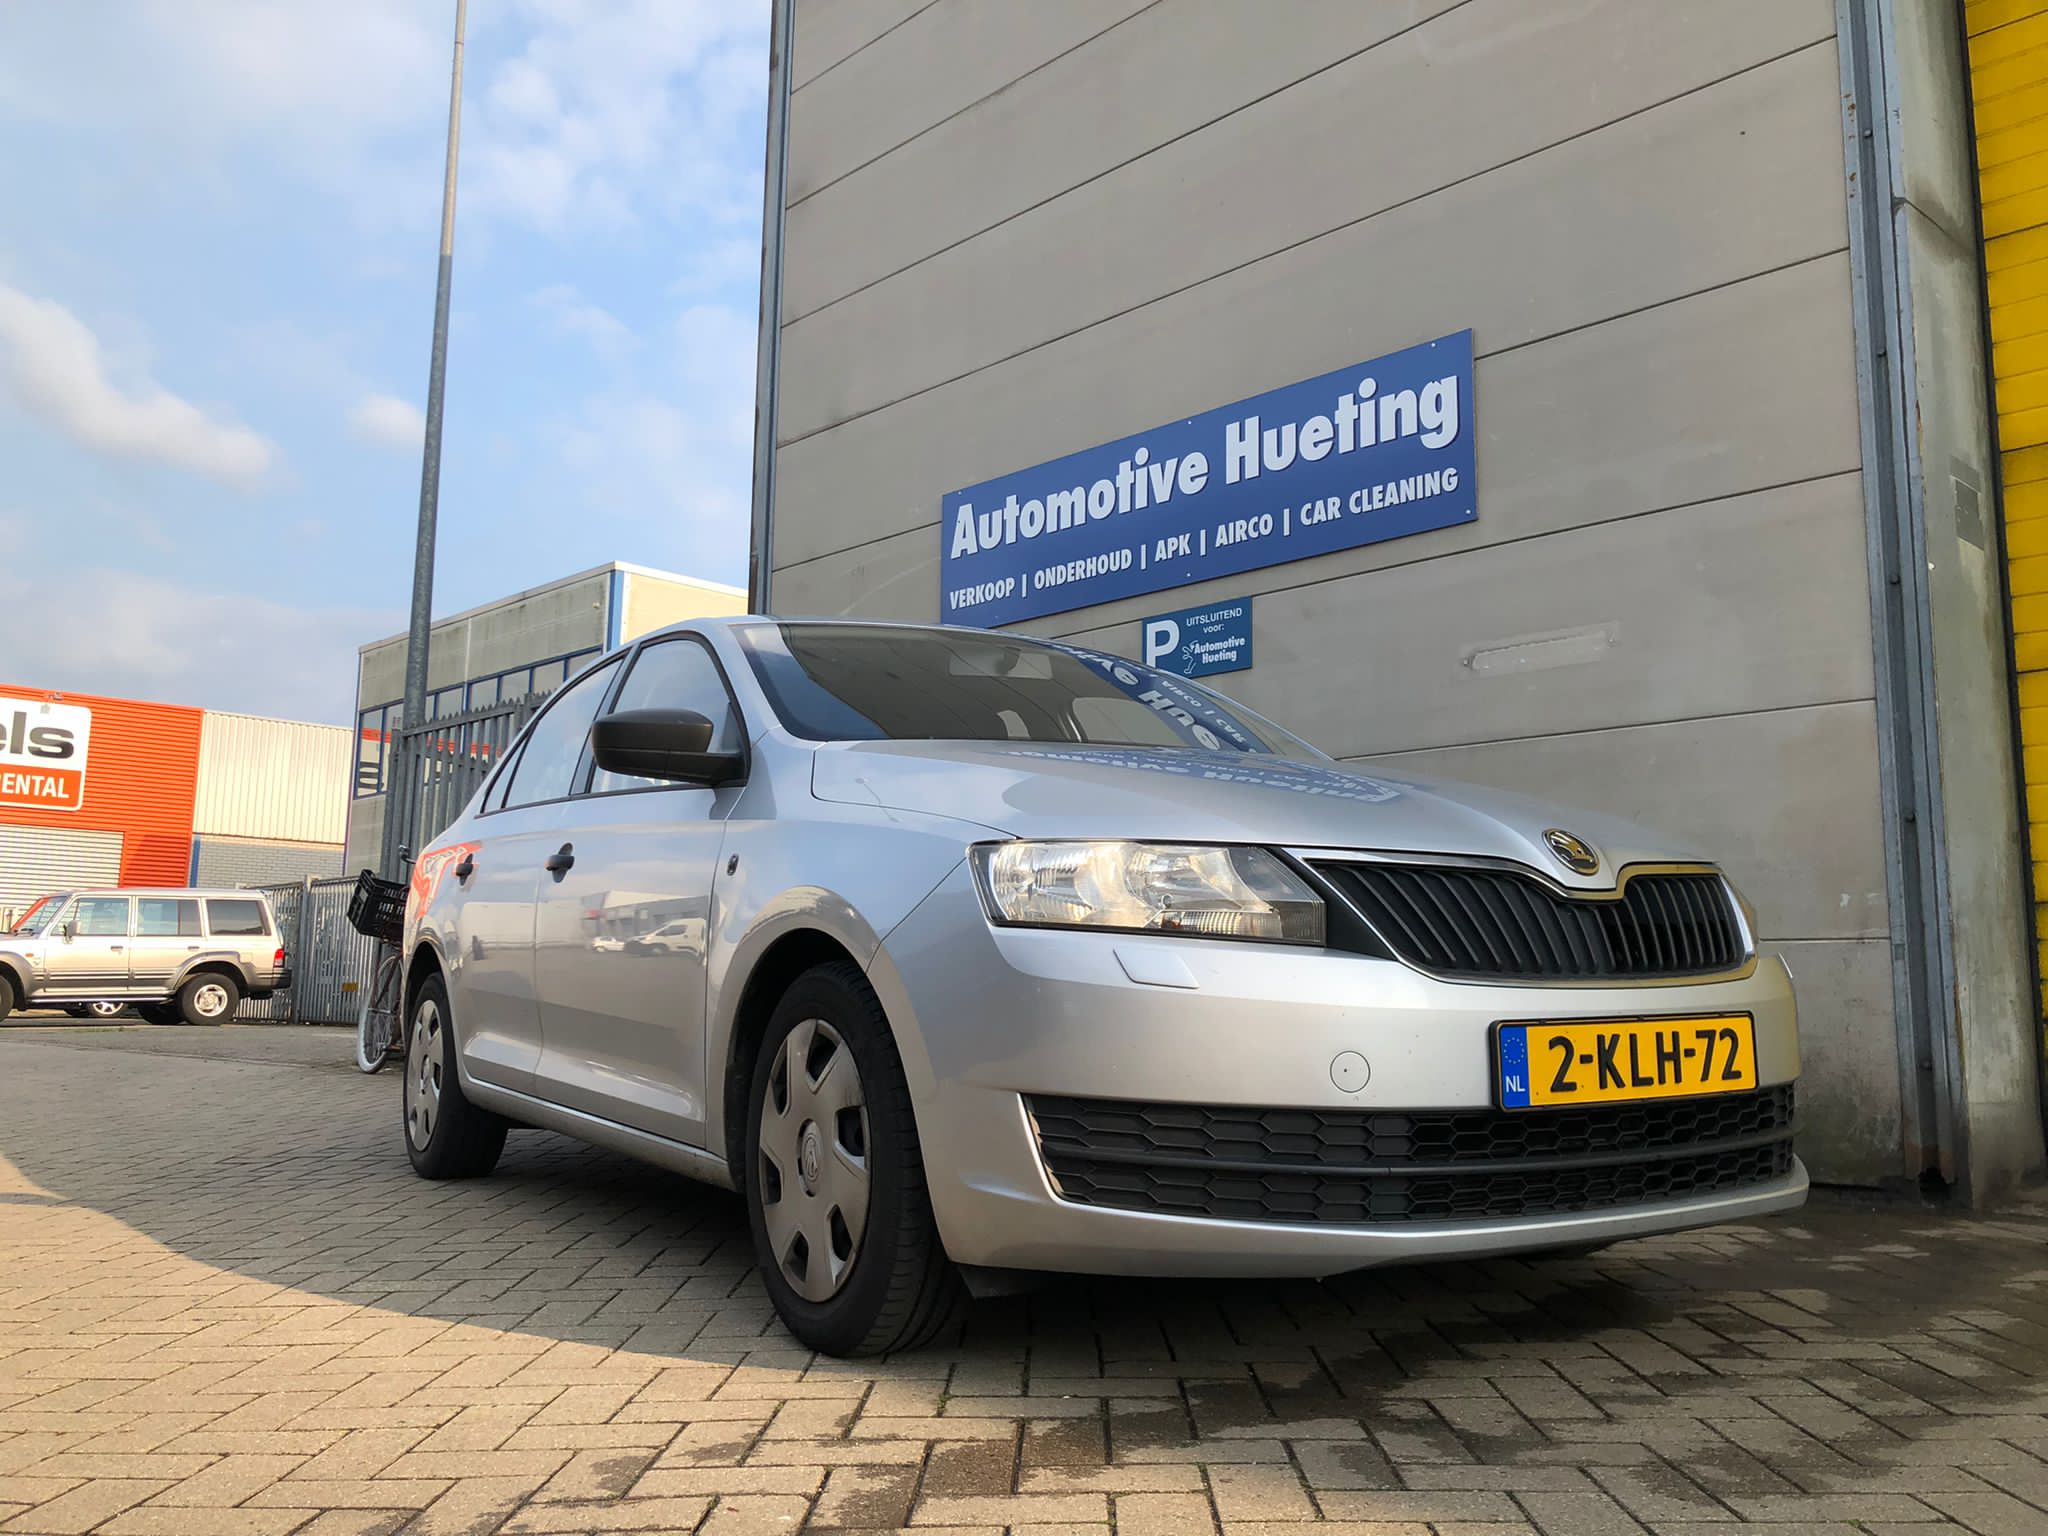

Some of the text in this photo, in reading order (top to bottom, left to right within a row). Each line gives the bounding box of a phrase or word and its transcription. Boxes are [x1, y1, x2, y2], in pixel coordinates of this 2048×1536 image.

[951, 375, 1458, 560] Automotive Hueting
[950, 577, 1015, 610] VERKOOP
[1034, 549, 1132, 590] ONDERHOUD
[1155, 533, 1191, 562] APK
[1215, 514, 1273, 548] AIRCO
[1300, 497, 1341, 526] CAR
[1349, 467, 1459, 514] CLEANING
[1186, 608, 1242, 626] UITSLUITEND
[1203, 623, 1225, 634] voor:
[1146, 620, 1179, 668] P
[1194, 635, 1245, 654] Automotive
[1202, 650, 1237, 664] Hueting
[0, 711, 74, 759] ls
[0, 772, 69, 798] ENTAL
[1548, 1028, 1742, 1093] 2-KLH-72
[1505, 1075, 1526, 1093] NL
